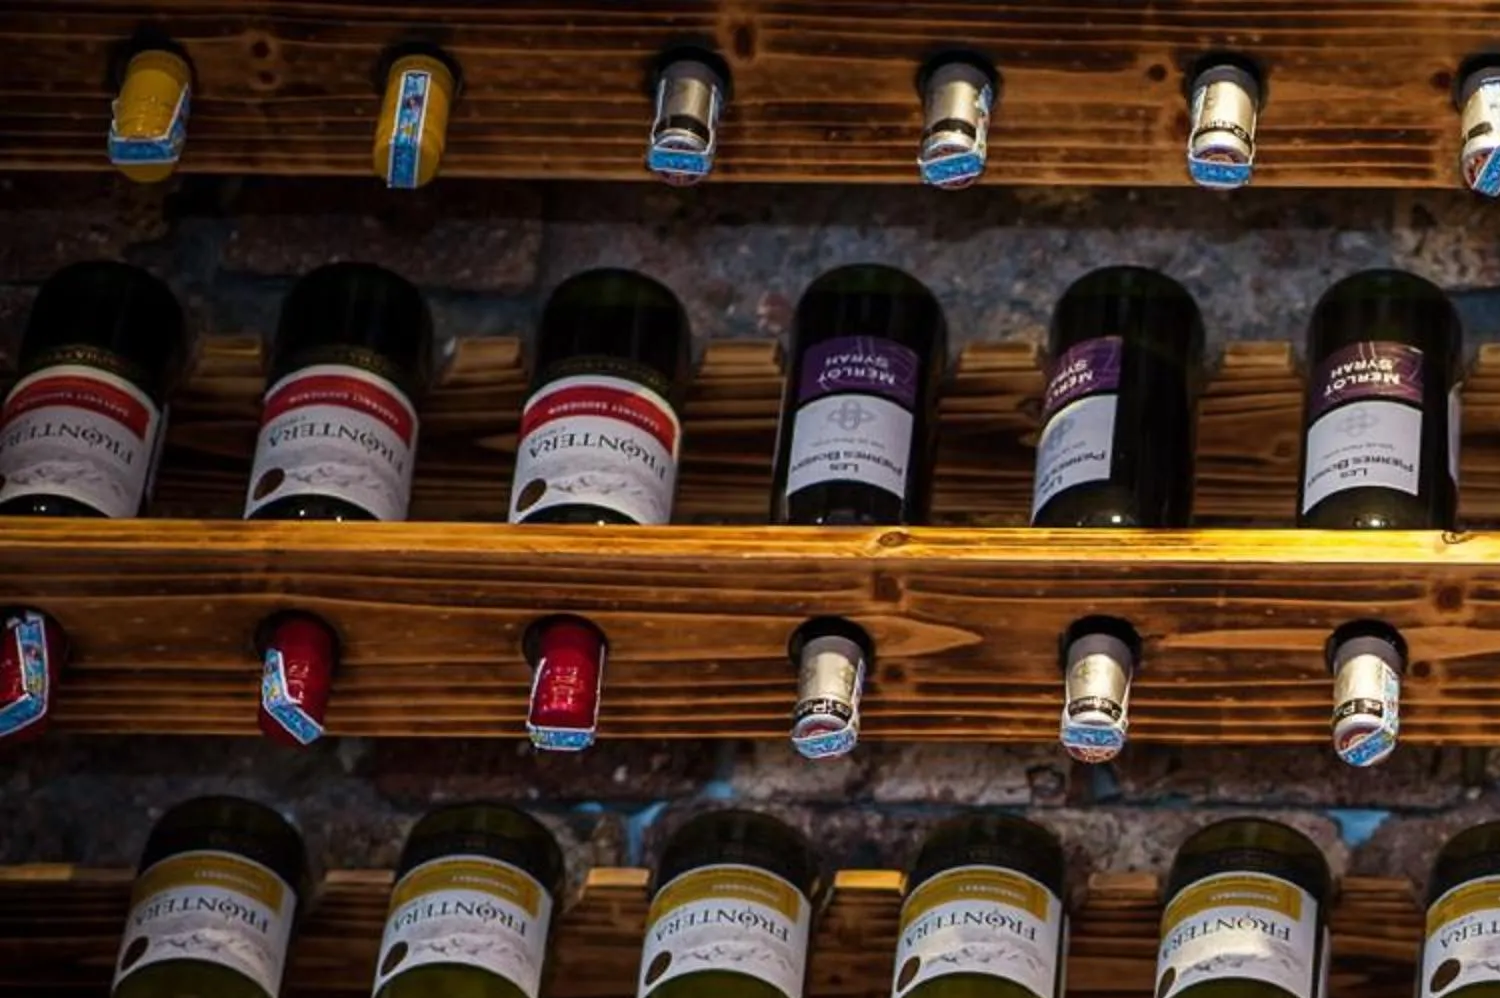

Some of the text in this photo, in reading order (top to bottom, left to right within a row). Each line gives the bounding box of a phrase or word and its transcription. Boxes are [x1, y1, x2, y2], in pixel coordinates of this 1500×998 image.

[817, 366, 896, 385] MERLOT
[825, 354, 890, 369] SYRAH
[1330, 357, 1394, 377] SYRAH
[1322, 371, 1401, 396] MERLOT
[267, 422, 404, 473] FRONTERA
[528, 434, 667, 480] FRONTERA
[135, 895, 269, 932] FRONTERA
[394, 900, 526, 937] FRONTERA
[655, 910, 789, 942] FRONTERA
[904, 911, 1036, 946] FRONTERA
[1161, 917, 1291, 959] FRONTERA
